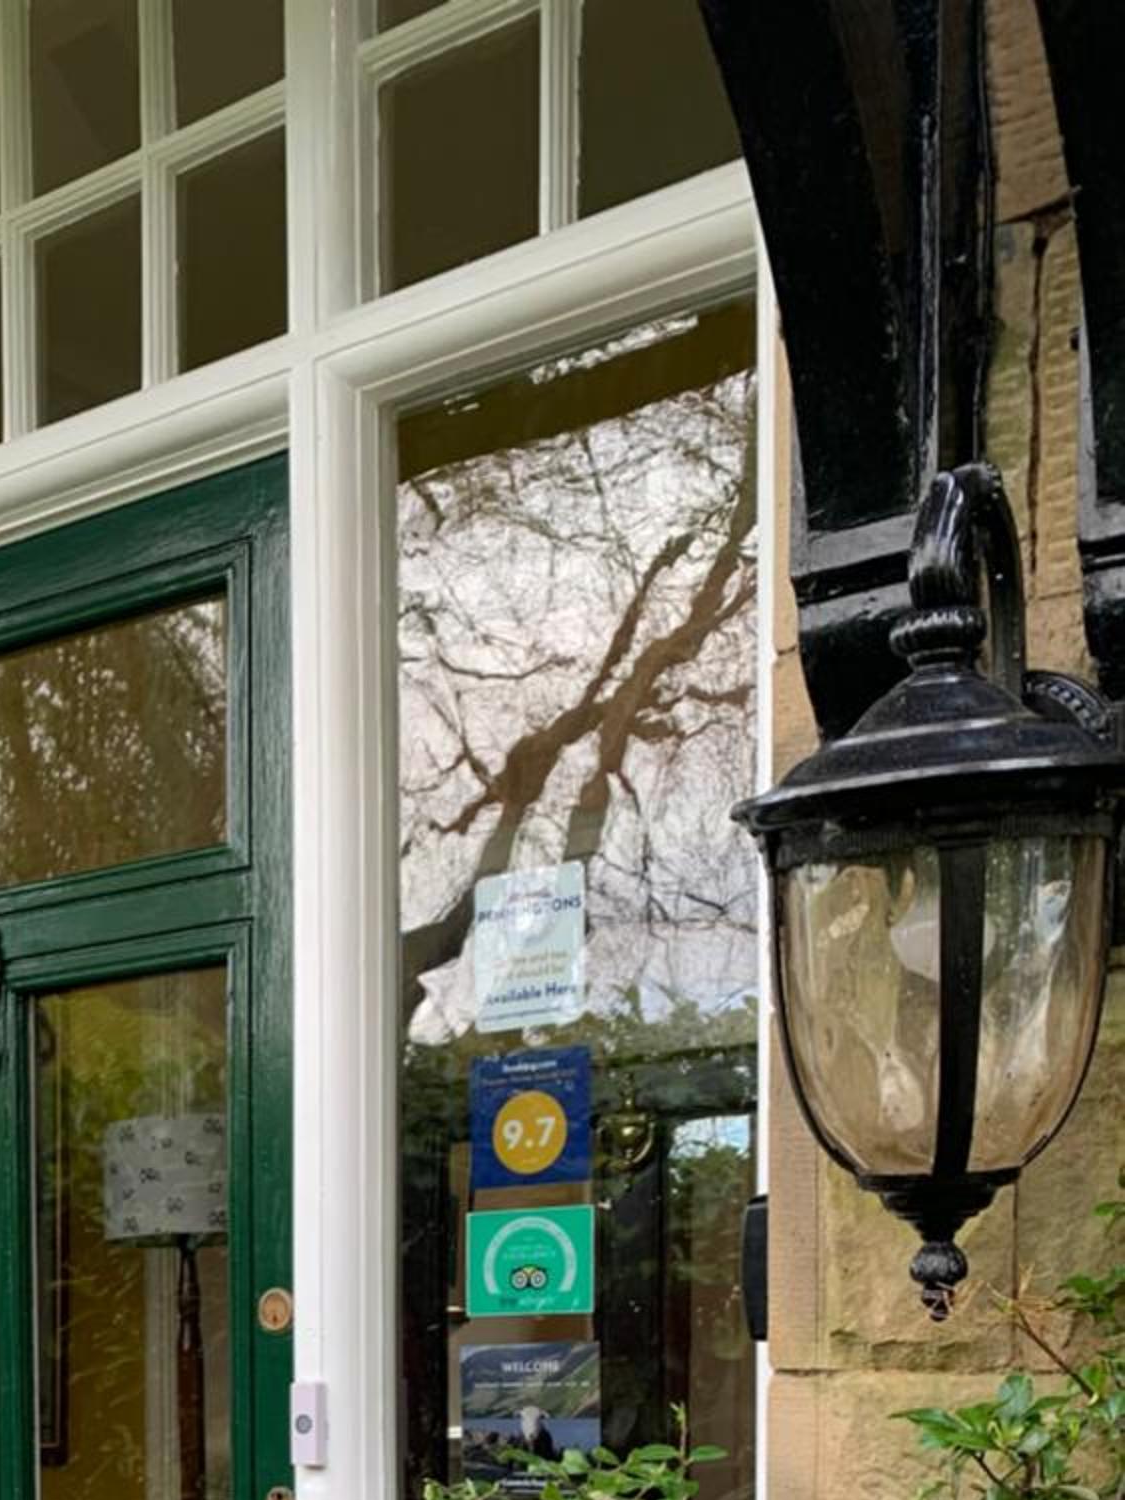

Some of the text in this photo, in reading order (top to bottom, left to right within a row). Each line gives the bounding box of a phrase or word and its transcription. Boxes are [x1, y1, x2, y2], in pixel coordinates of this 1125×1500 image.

[545, 981, 577, 997] Here
[502, 1116, 556, 1151] 9.7
[501, 1360, 559, 1373] WELCOME
